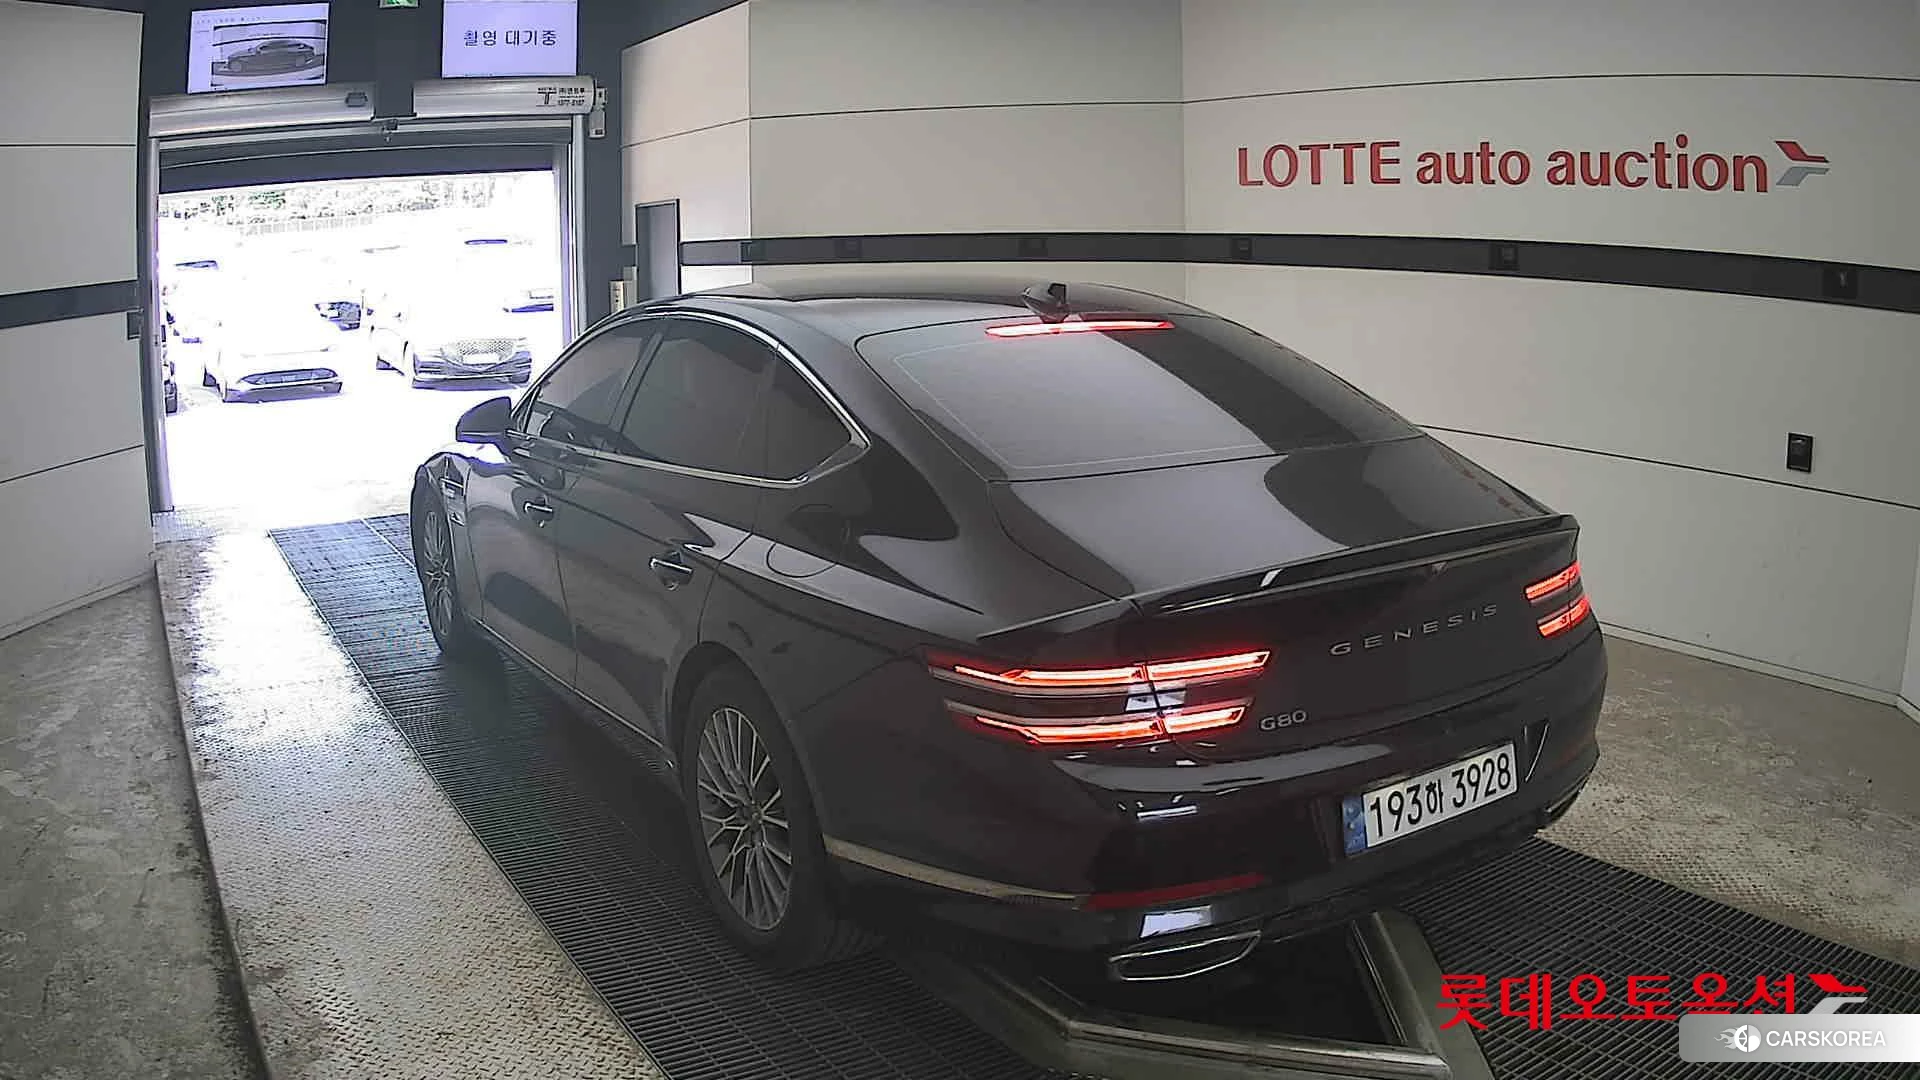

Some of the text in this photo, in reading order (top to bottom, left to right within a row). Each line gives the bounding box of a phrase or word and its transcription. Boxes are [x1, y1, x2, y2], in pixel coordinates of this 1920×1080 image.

[505, 30, 557, 46] 대기중
[1239, 134, 1768, 192] LOTTE auto auction
[1330, 604, 1497, 656] GENESIS
[1260, 710, 1307, 731] G80
[1370, 753, 1511, 837] 193하 3928
